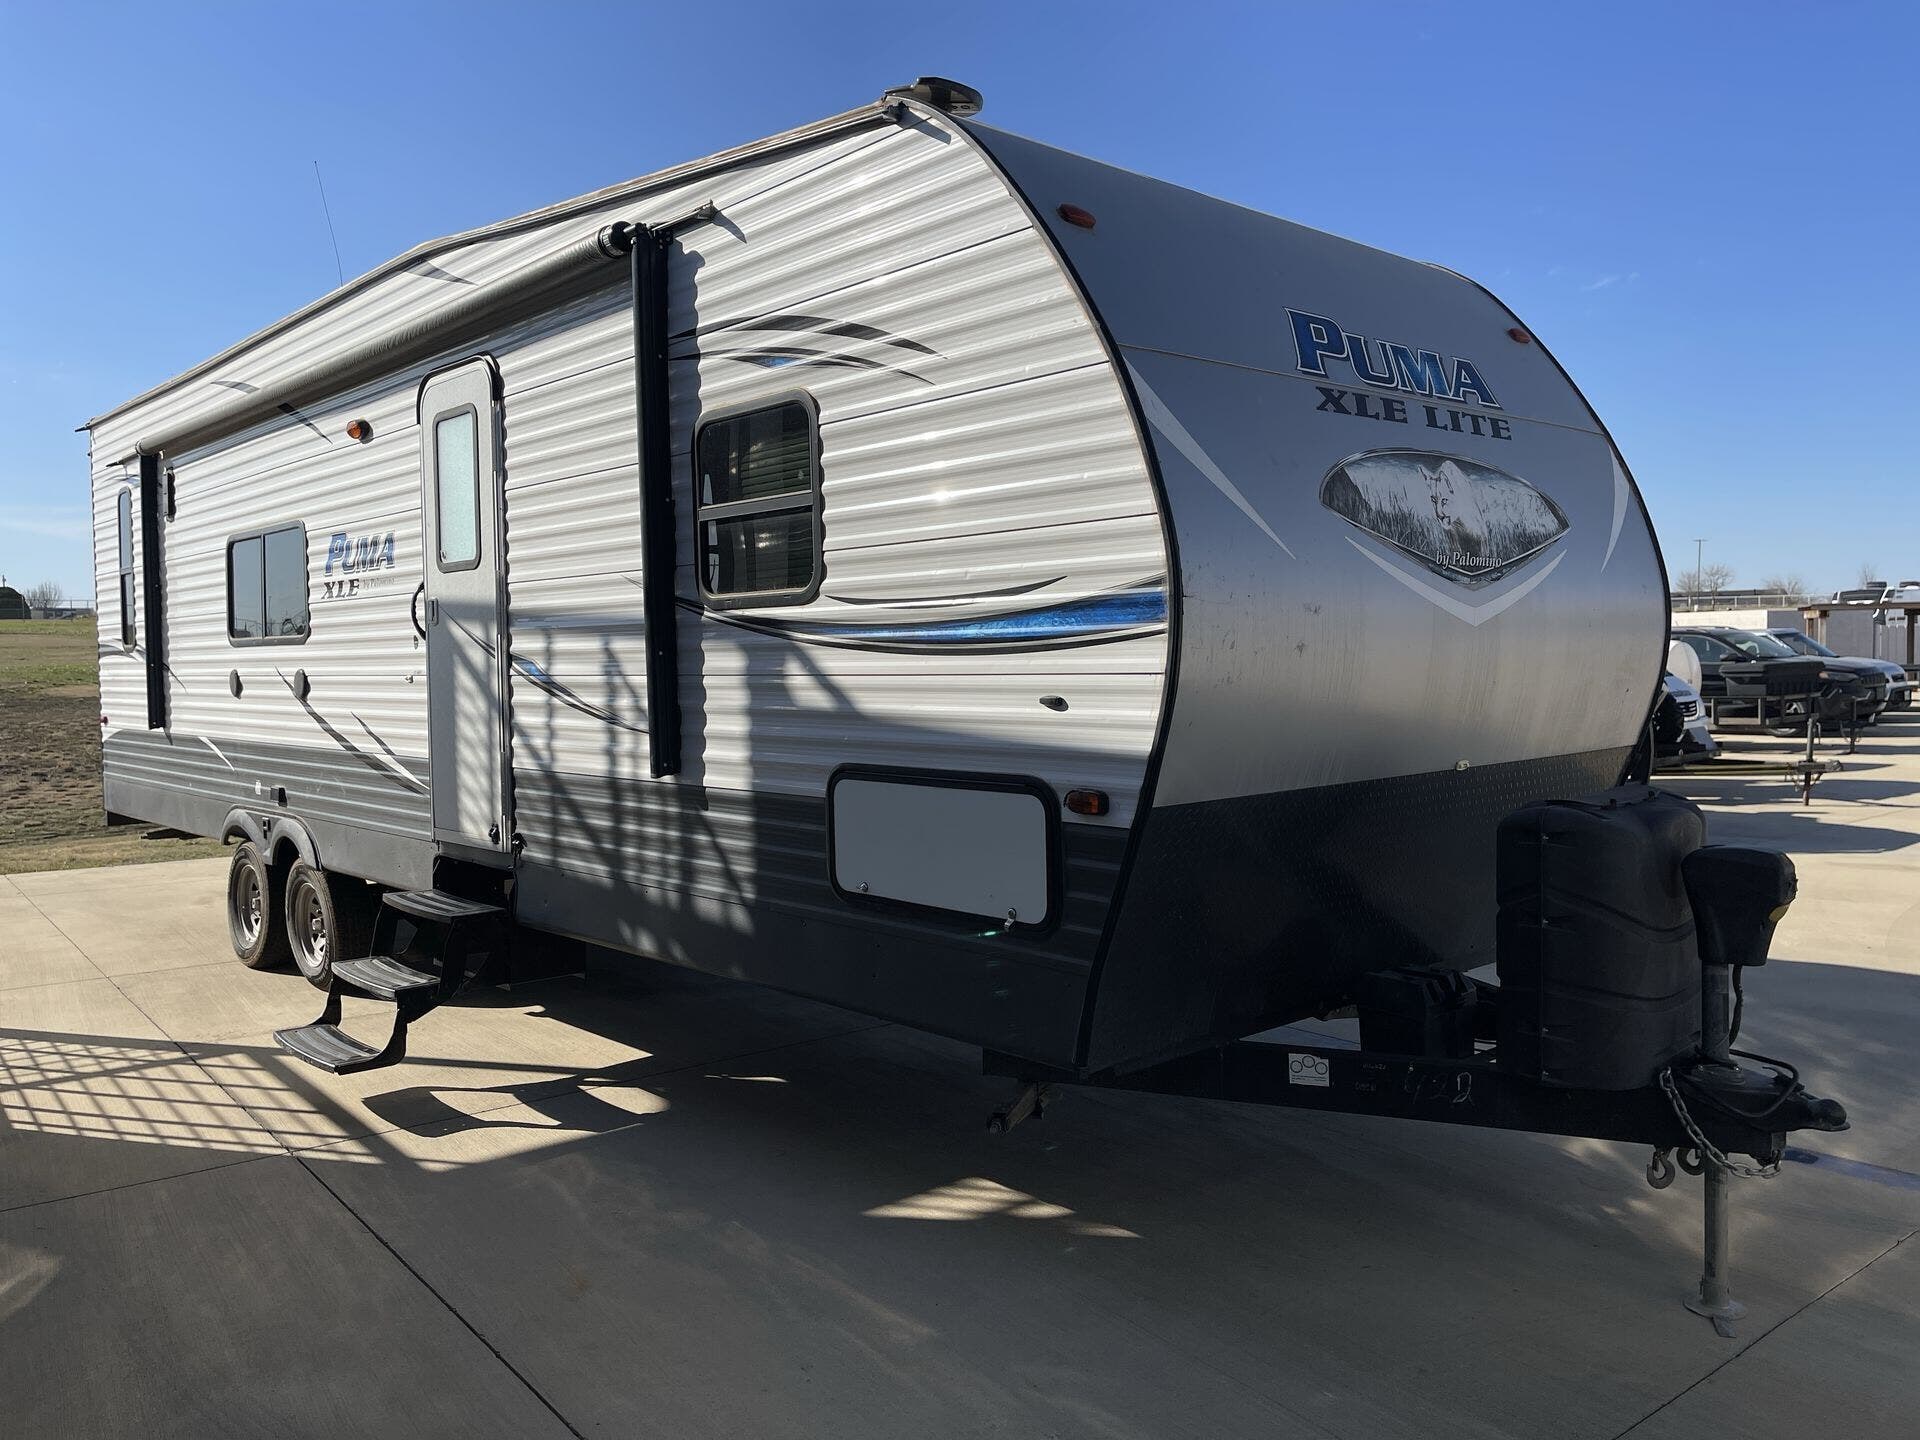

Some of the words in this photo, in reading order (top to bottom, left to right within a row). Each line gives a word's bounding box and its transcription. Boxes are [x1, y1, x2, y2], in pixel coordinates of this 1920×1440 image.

[1284, 307, 1504, 410] PUMA
[1316, 386, 1408, 423] XLE
[1423, 405, 1512, 440] LITE
[323, 530, 395, 577] PUMA
[1436, 551, 1449, 569] by
[1452, 551, 1502, 568] Palomino
[321, 579, 360, 600] XLE
